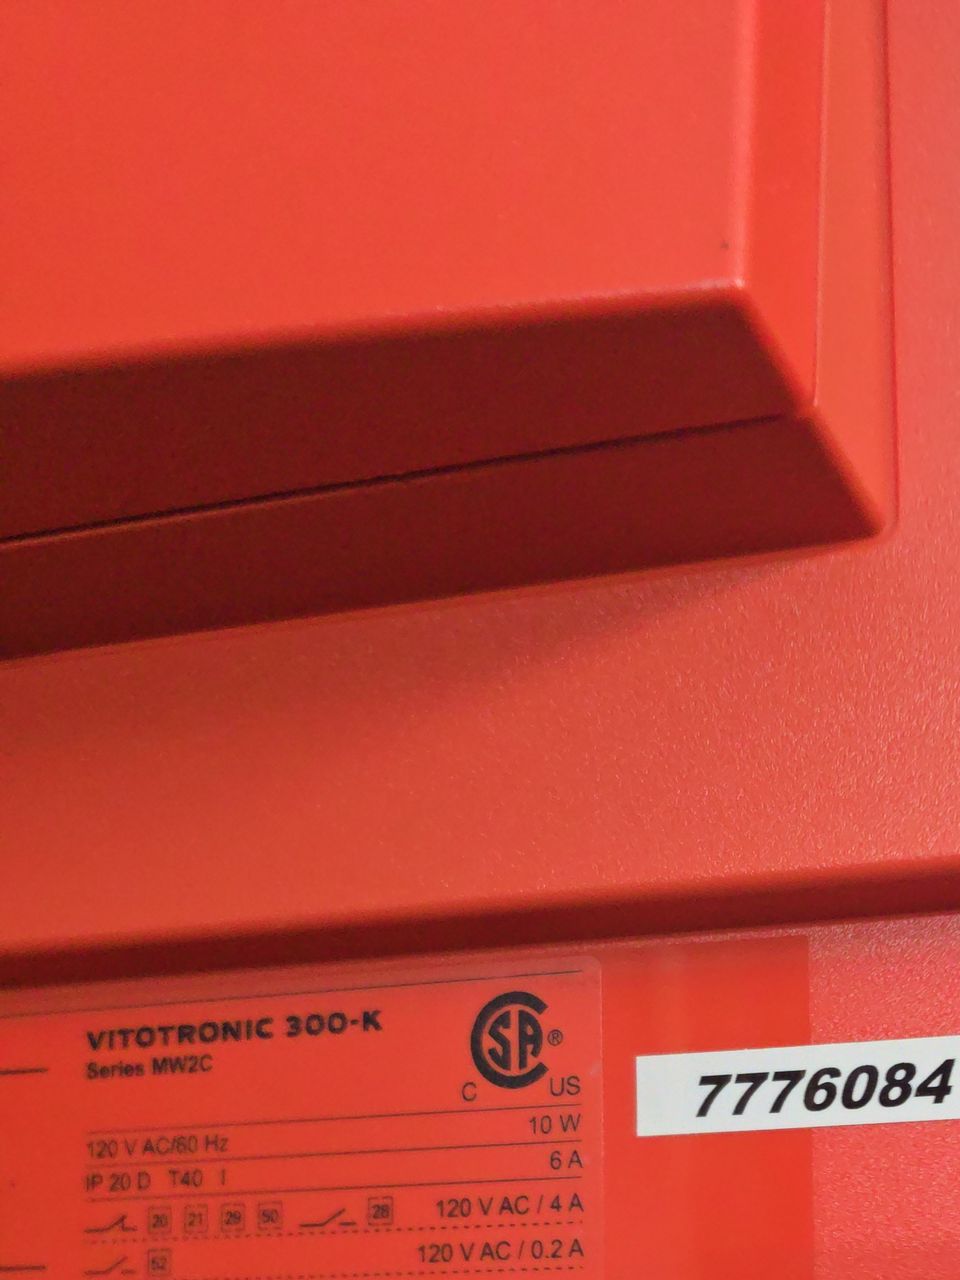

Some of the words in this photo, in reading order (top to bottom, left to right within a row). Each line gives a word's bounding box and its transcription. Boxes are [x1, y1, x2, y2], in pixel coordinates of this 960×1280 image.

[87, 1017, 274, 1050] VITOTRONIC
[286, 1010, 383, 1038] 300-K
[86, 1061, 145, 1080] Series
[152, 1054, 213, 1076] MW2C
[550, 1075, 581, 1096] US
[695, 1058, 957, 1118] 7776084
[529, 1115, 552, 1134] 10
[560, 1113, 582, 1132] W
[87, 1140, 118, 1159] 120
[124, 1138, 138, 1156] V
[205, 1134, 229, 1152] Hz
[550, 1151, 562, 1170] 6
[568, 1150, 583, 1169] A
[110, 1172, 131, 1191] 20
[168, 1168, 203, 1188] T40
[436, 1198, 471, 1218] 120
[479, 1197, 493, 1216] V
[500, 1195, 530, 1215] AC
[550, 1195, 562, 1211] 4
[568, 1193, 584, 1212] A
[418, 1243, 453, 1263] 120
[460, 1242, 475, 1261] V
[480, 1241, 511, 1260] AC
[531, 1239, 562, 1259] 0.2
[568, 1238, 584, 1257] A
